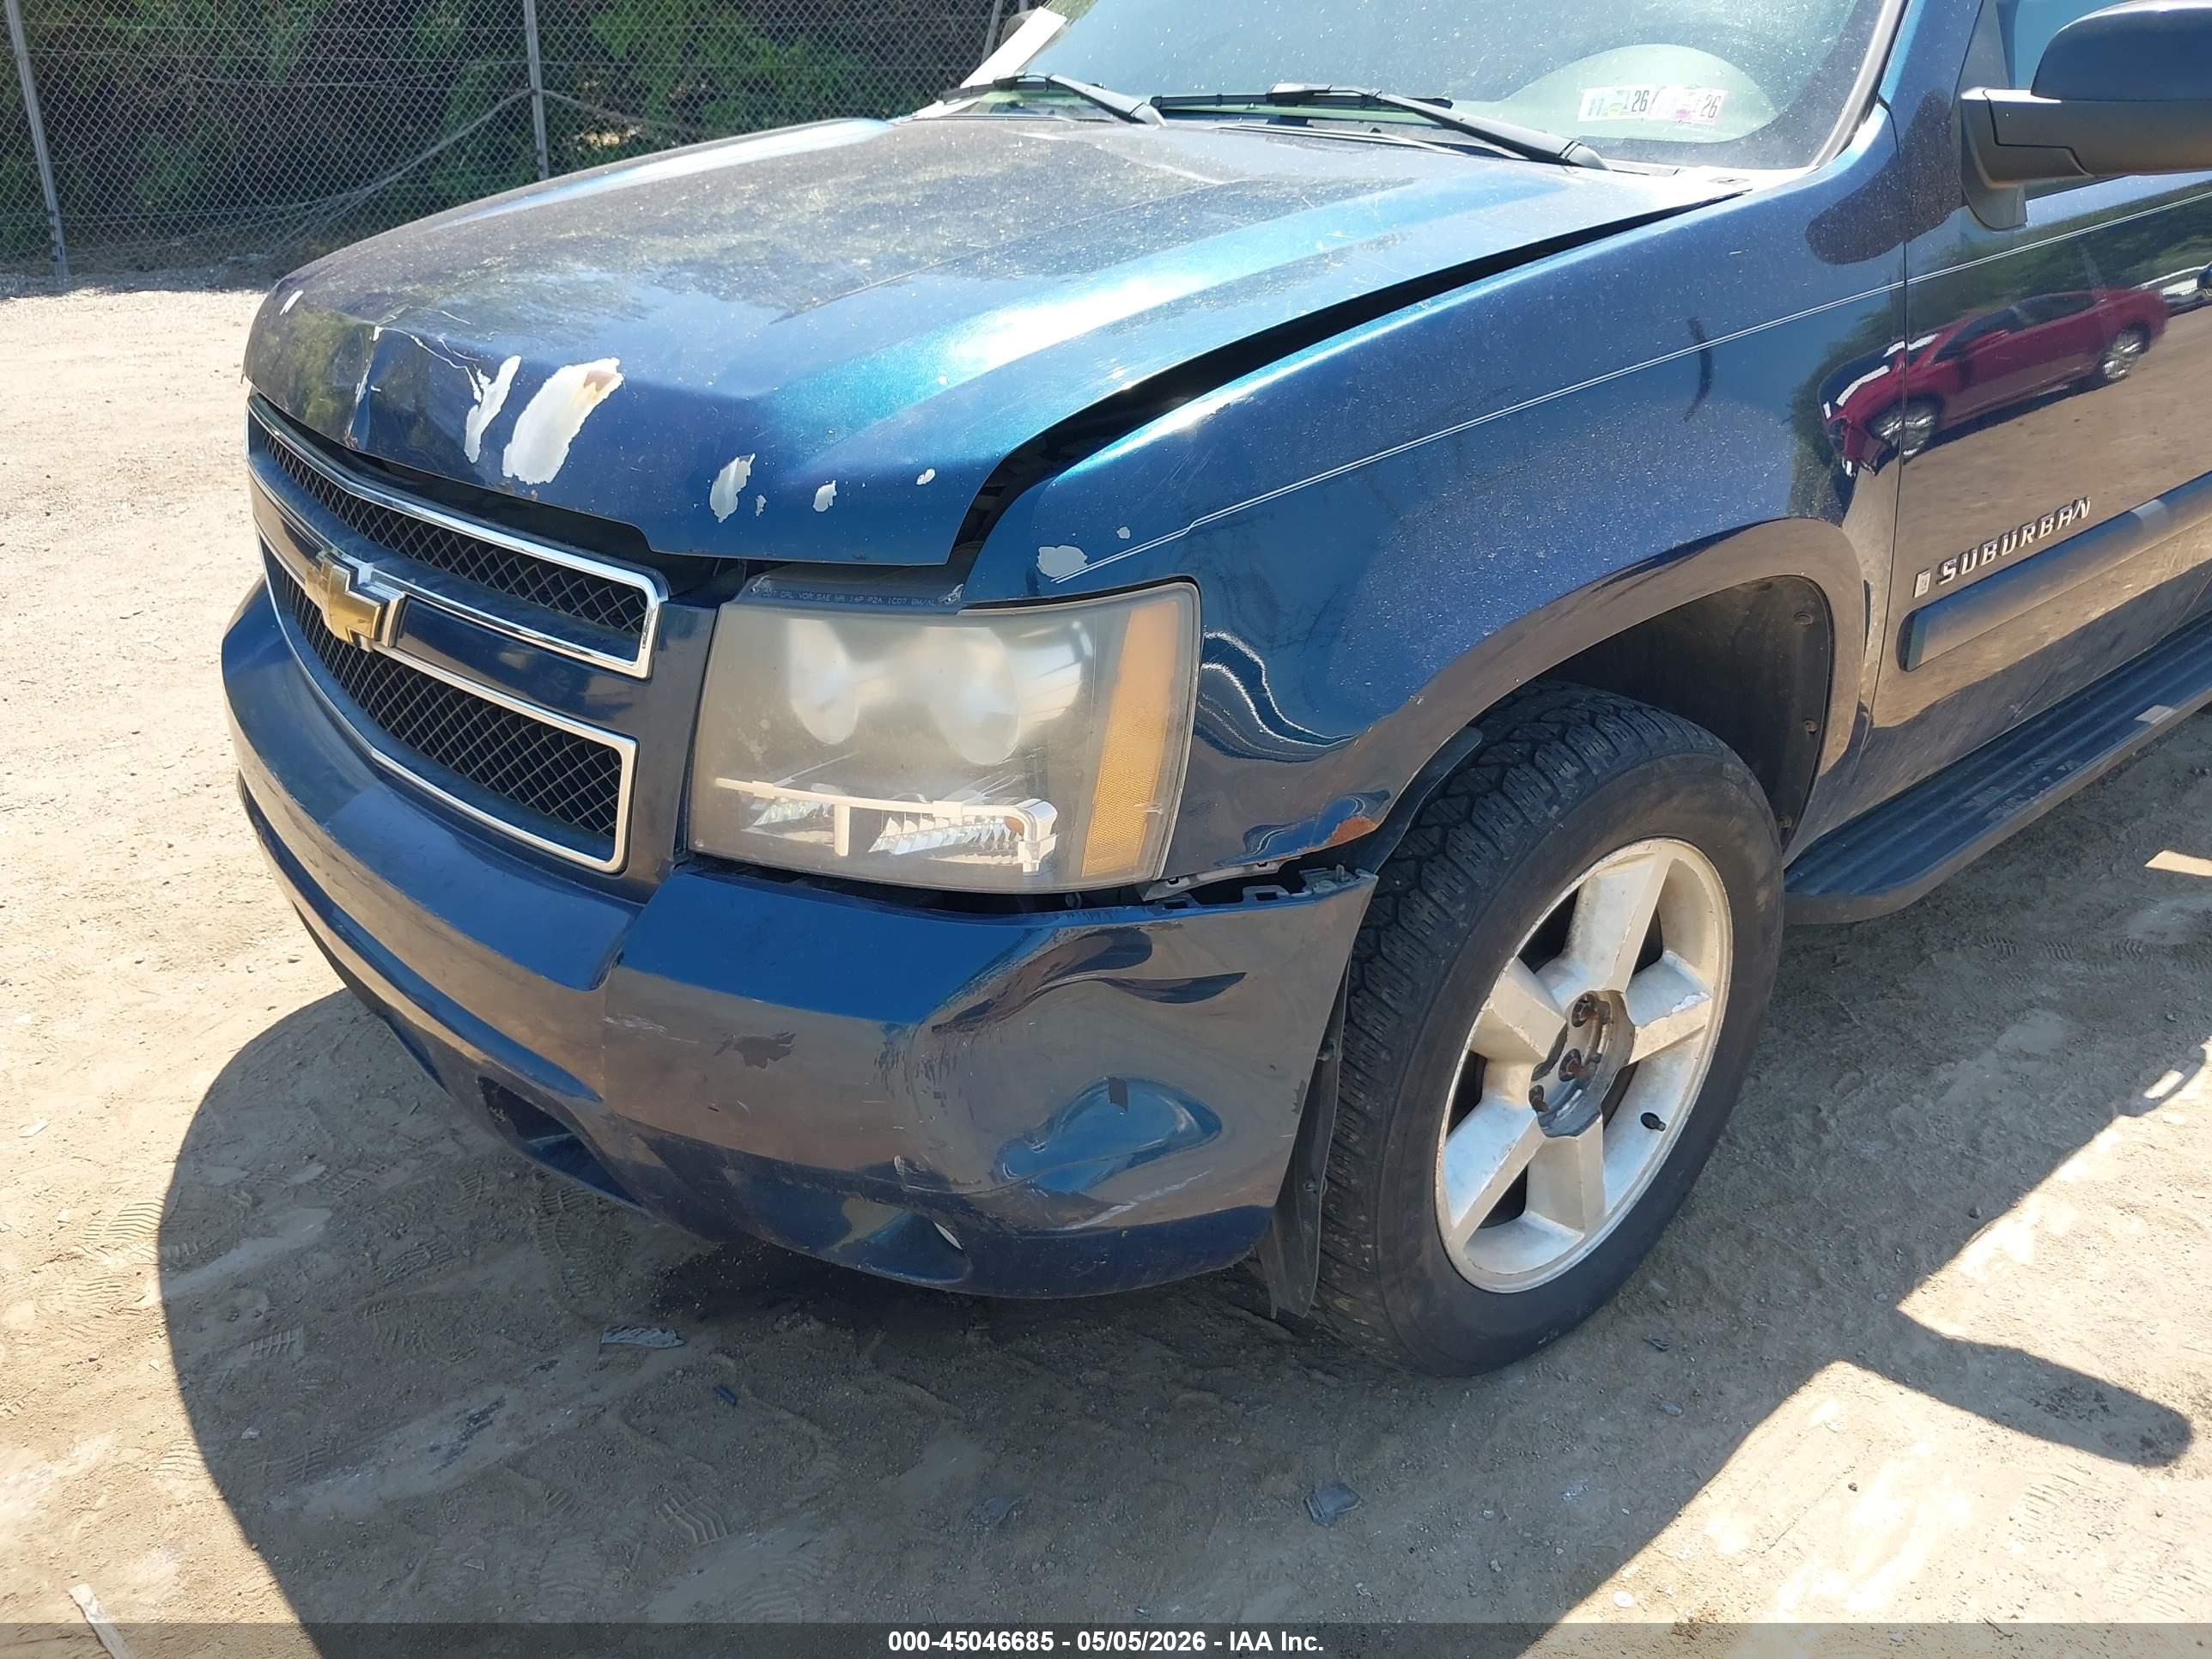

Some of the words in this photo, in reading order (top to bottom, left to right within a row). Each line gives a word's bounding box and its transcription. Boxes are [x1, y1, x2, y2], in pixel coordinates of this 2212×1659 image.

[1632, 89, 1650, 112] 26
[1699, 94, 1721, 118] 26
[1936, 495, 2091, 586] SUBURBAN
